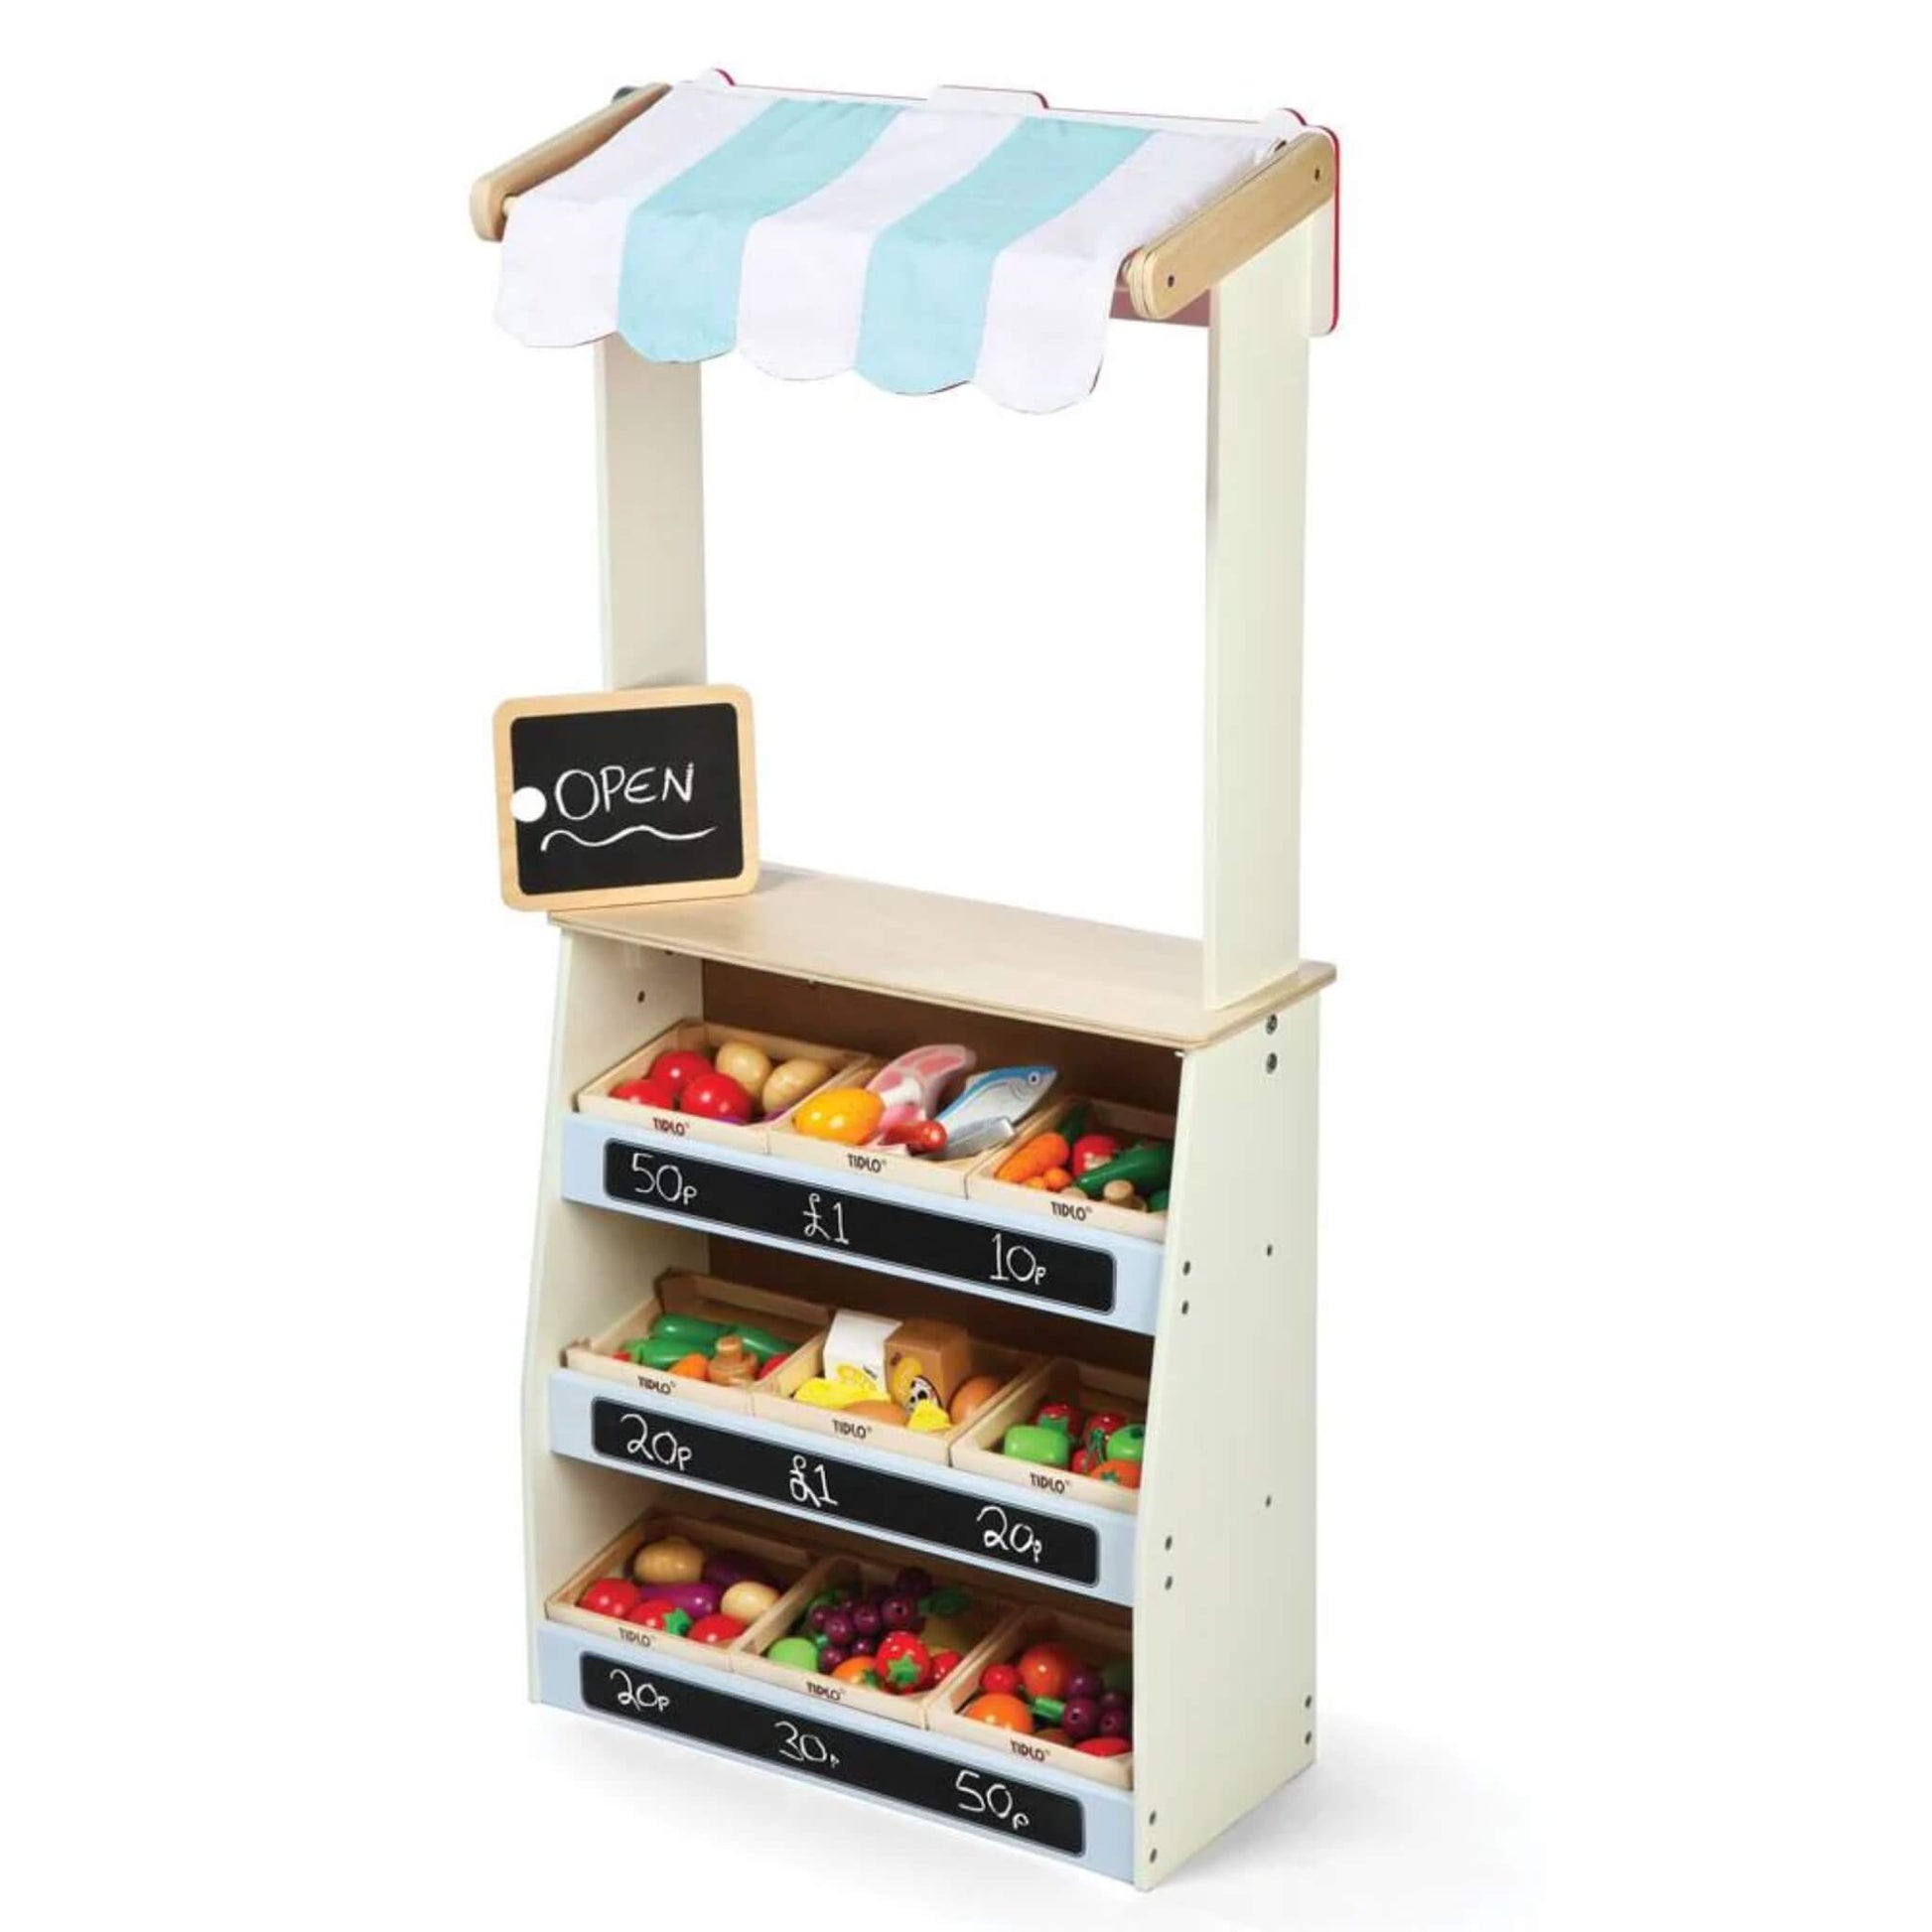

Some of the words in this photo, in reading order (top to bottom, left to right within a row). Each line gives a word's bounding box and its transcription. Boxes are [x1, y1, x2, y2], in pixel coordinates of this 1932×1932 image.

[554, 761, 695, 821] OPEN
[630, 1152, 698, 1205] 50p
[802, 1192, 850, 1245] £1
[989, 1232, 1047, 1286] 10p
[620, 1413, 694, 1471] 20p
[788, 1453, 839, 1508] £1
[975, 1504, 1043, 1564] 20p
[609, 1668, 671, 1713] 20p
[773, 1720, 841, 1768] 30p
[954, 1768, 1031, 1831] 50p
